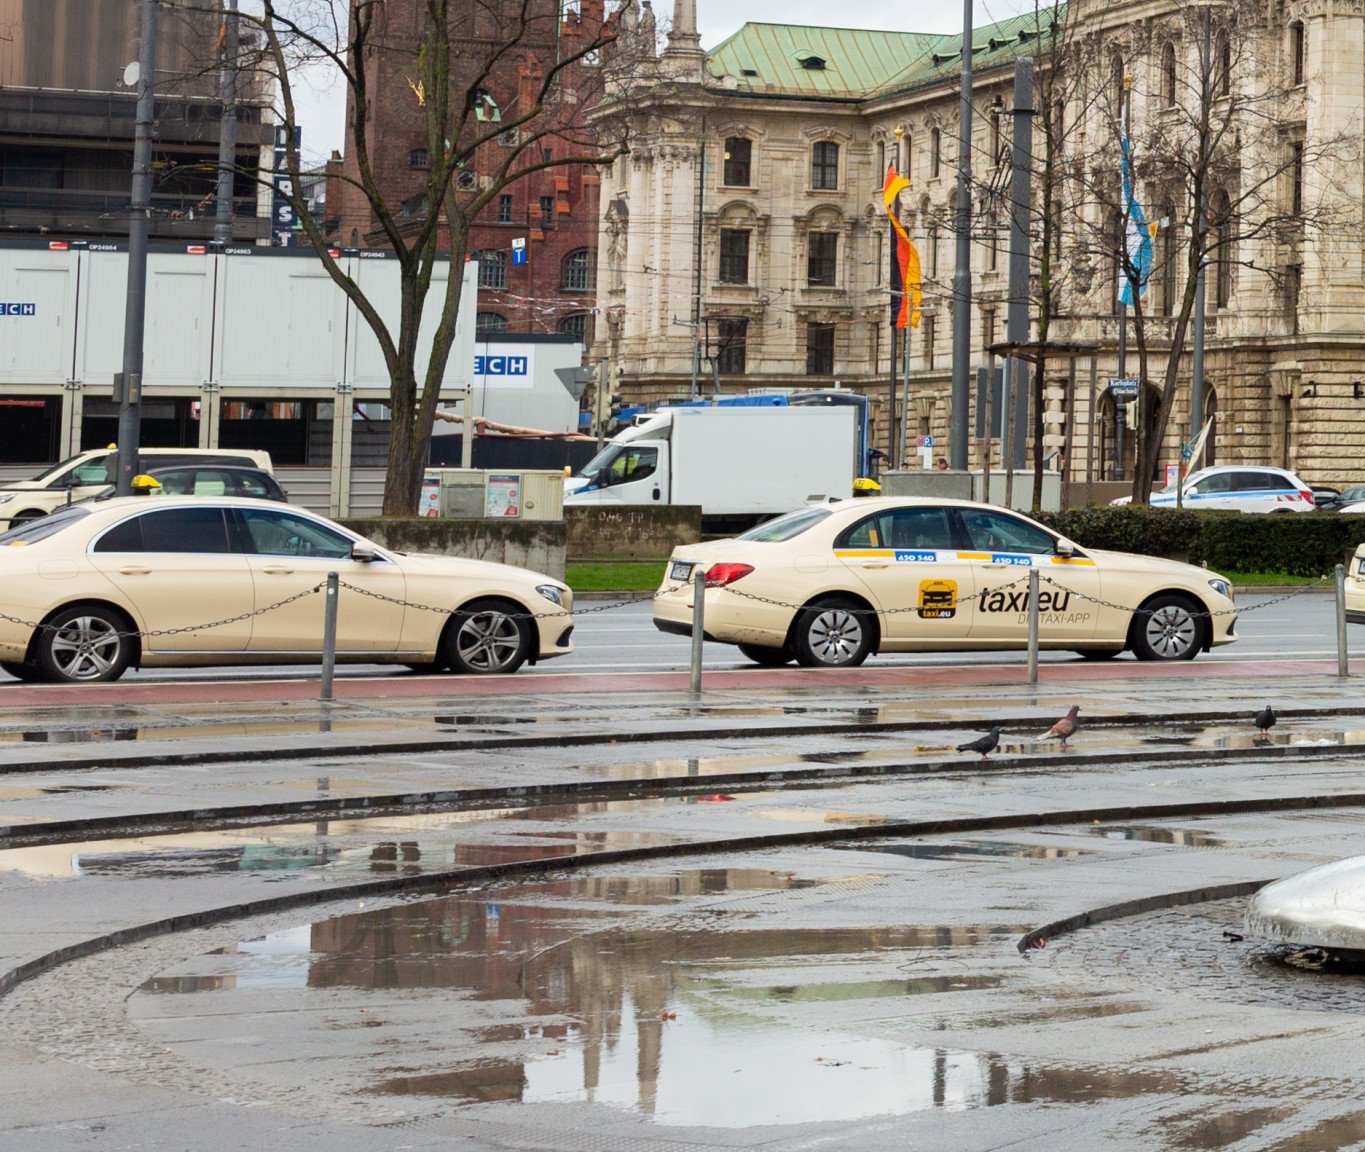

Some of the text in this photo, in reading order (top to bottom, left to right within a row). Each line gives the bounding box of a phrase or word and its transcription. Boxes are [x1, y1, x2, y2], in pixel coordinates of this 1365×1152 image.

[1110, 380, 1136, 388] Karlsplatz
[979, 585, 1070, 613] taxieu
[922, 608, 951, 618] taxi.eu
[1041, 613, 1091, 624] TAXI-APP
